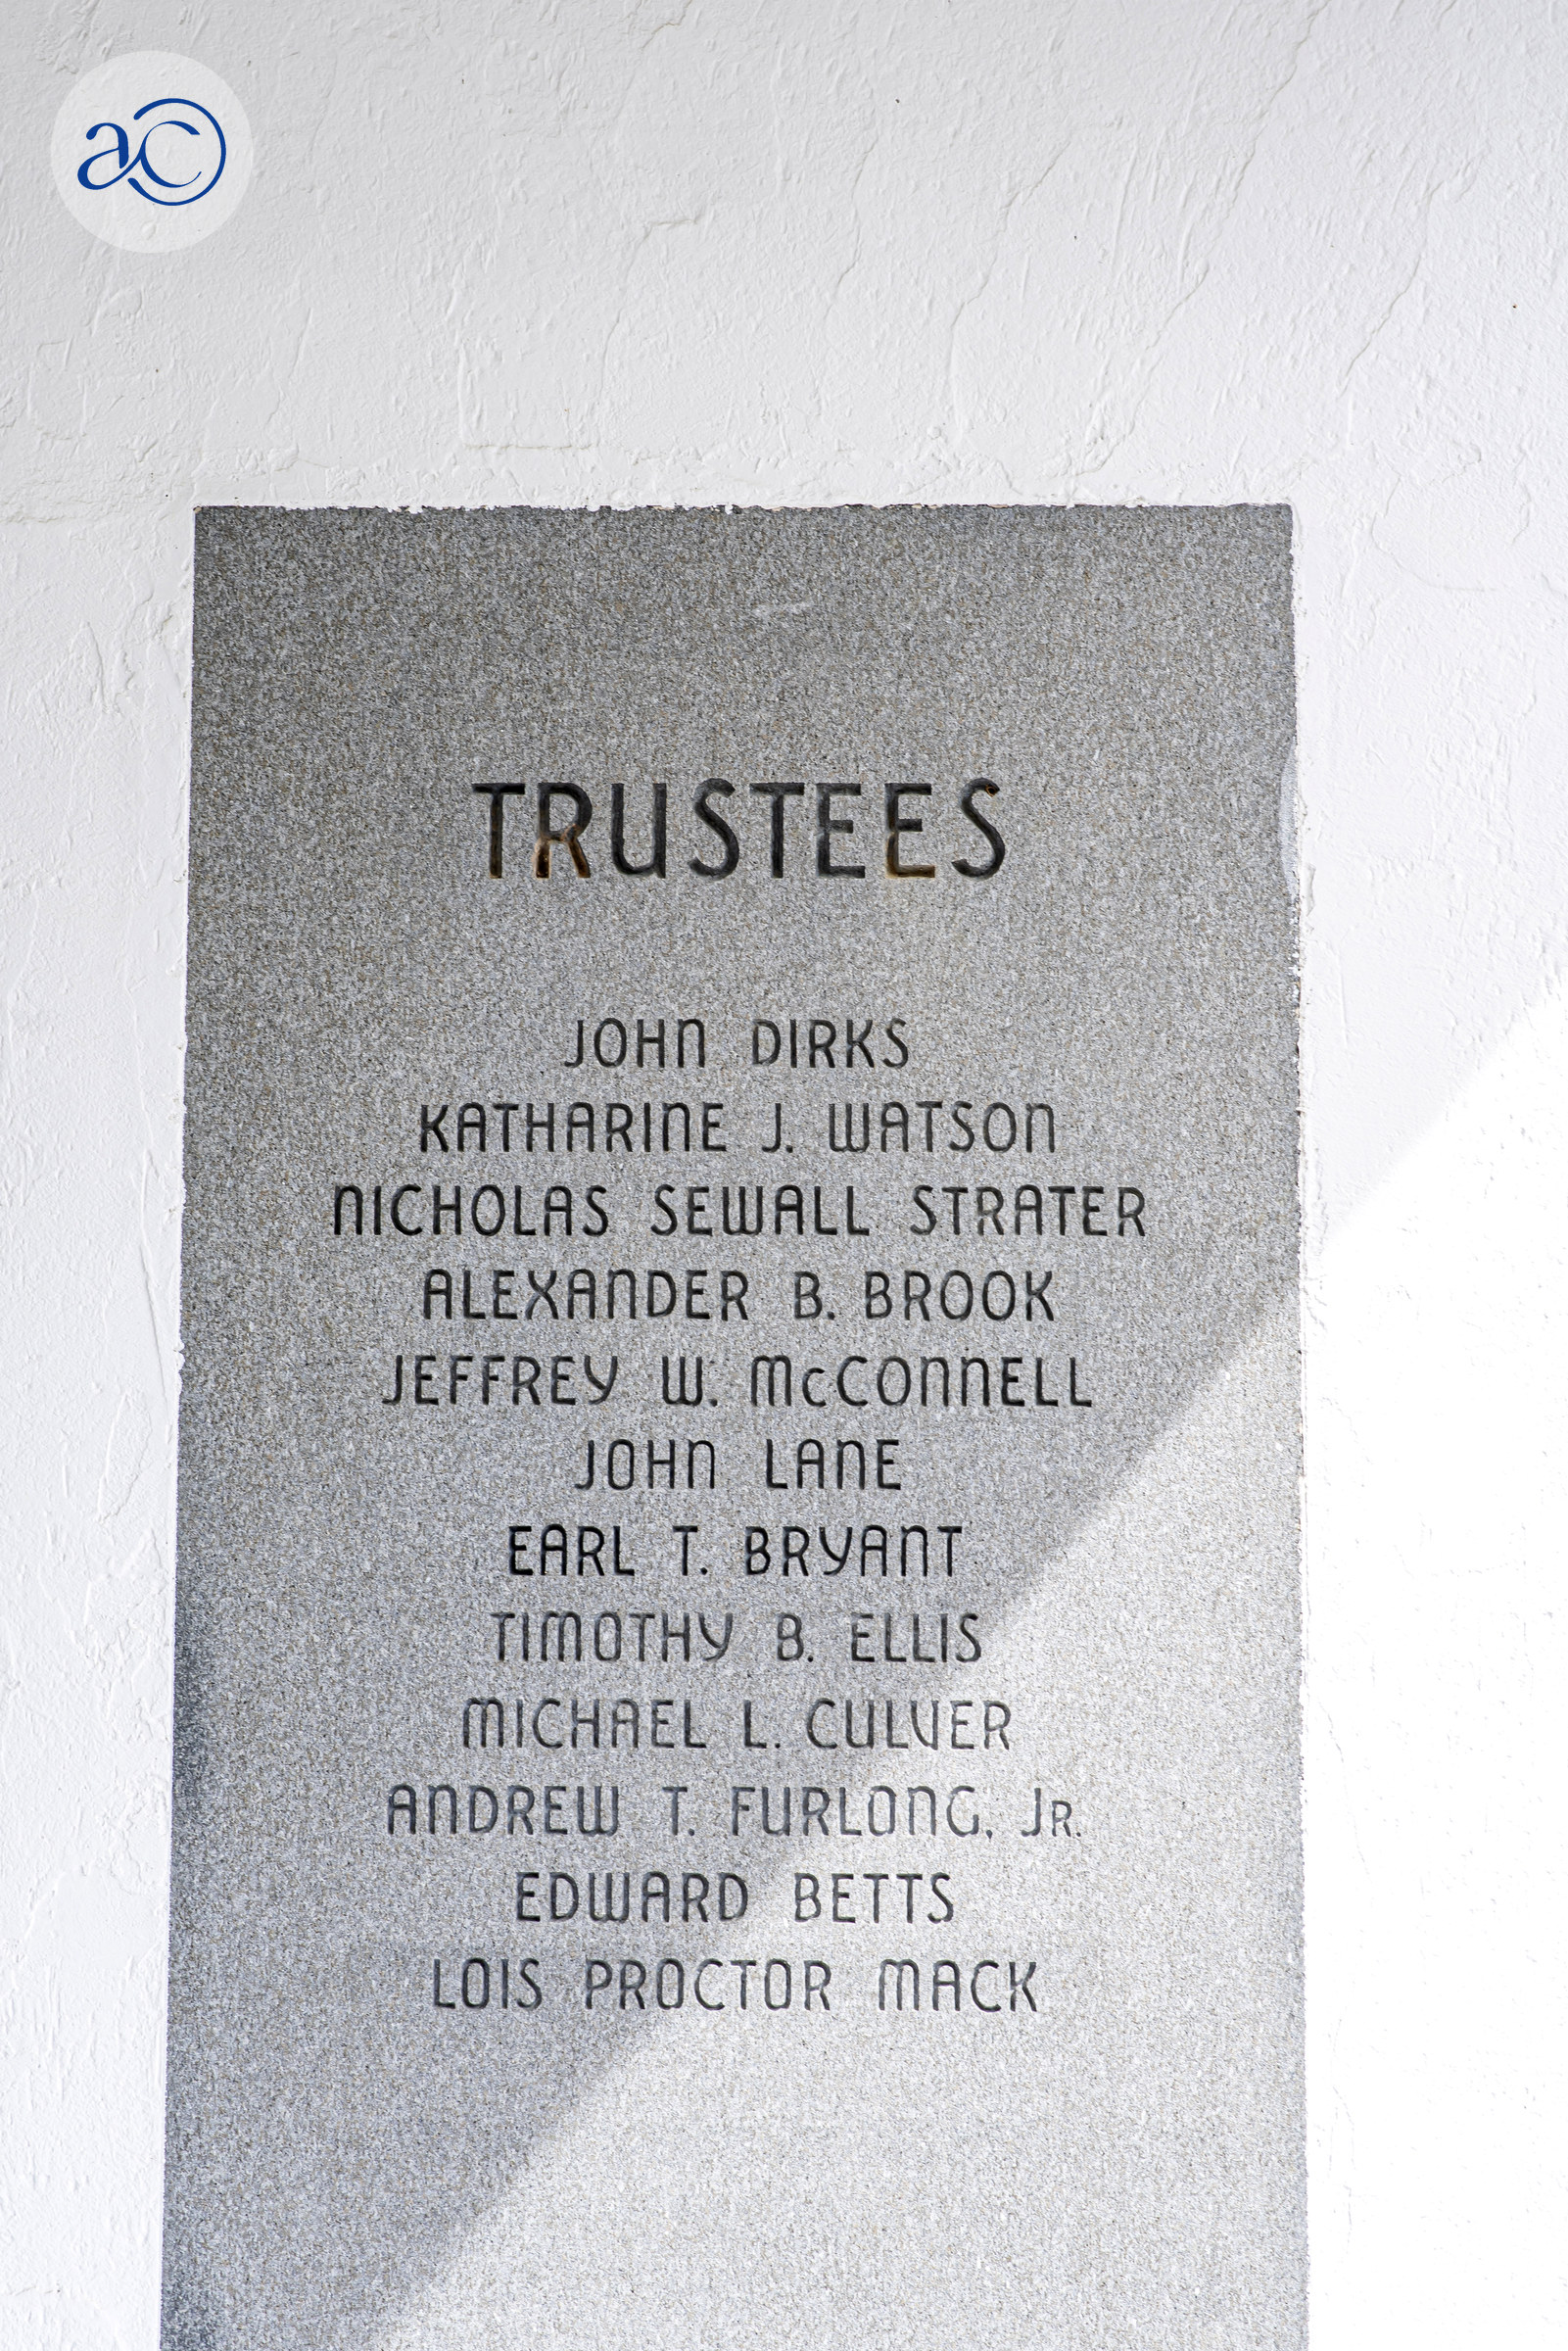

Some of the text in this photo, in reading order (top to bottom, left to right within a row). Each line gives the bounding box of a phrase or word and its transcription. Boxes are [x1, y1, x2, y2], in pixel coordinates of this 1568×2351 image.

[471, 777, 1007, 881] TRUSTEES
[562, 1017, 910, 1070] JOHN DIRKS
[419, 1100, 1056, 1154] KATHARINE J. WATSON
[332, 1183, 1146, 1238] NICHOLAS SEWALL STRATER
[422, 1268, 1055, 1322] ALEXANDER B. BROOK
[382, 1354, 1094, 1409] JEFFREY W. McCONNELL
[574, 1438, 902, 1491] JOHN LANE
[507, 1522, 964, 1578] EARL T. BRYANT
[491, 1610, 982, 1664] TIMOTHY B. ELLIS
[462, 1697, 1012, 1751] MICHAEL L. CULVER
[387, 1783, 620, 1837] ANDREW
[662, 1786, 695, 1837] T.
[731, 1785, 993, 1840] FURLONG,
[515, 1870, 955, 1924] EDWARD BETTS
[433, 1956, 1037, 2013] LOIS PROCTOR MACK
